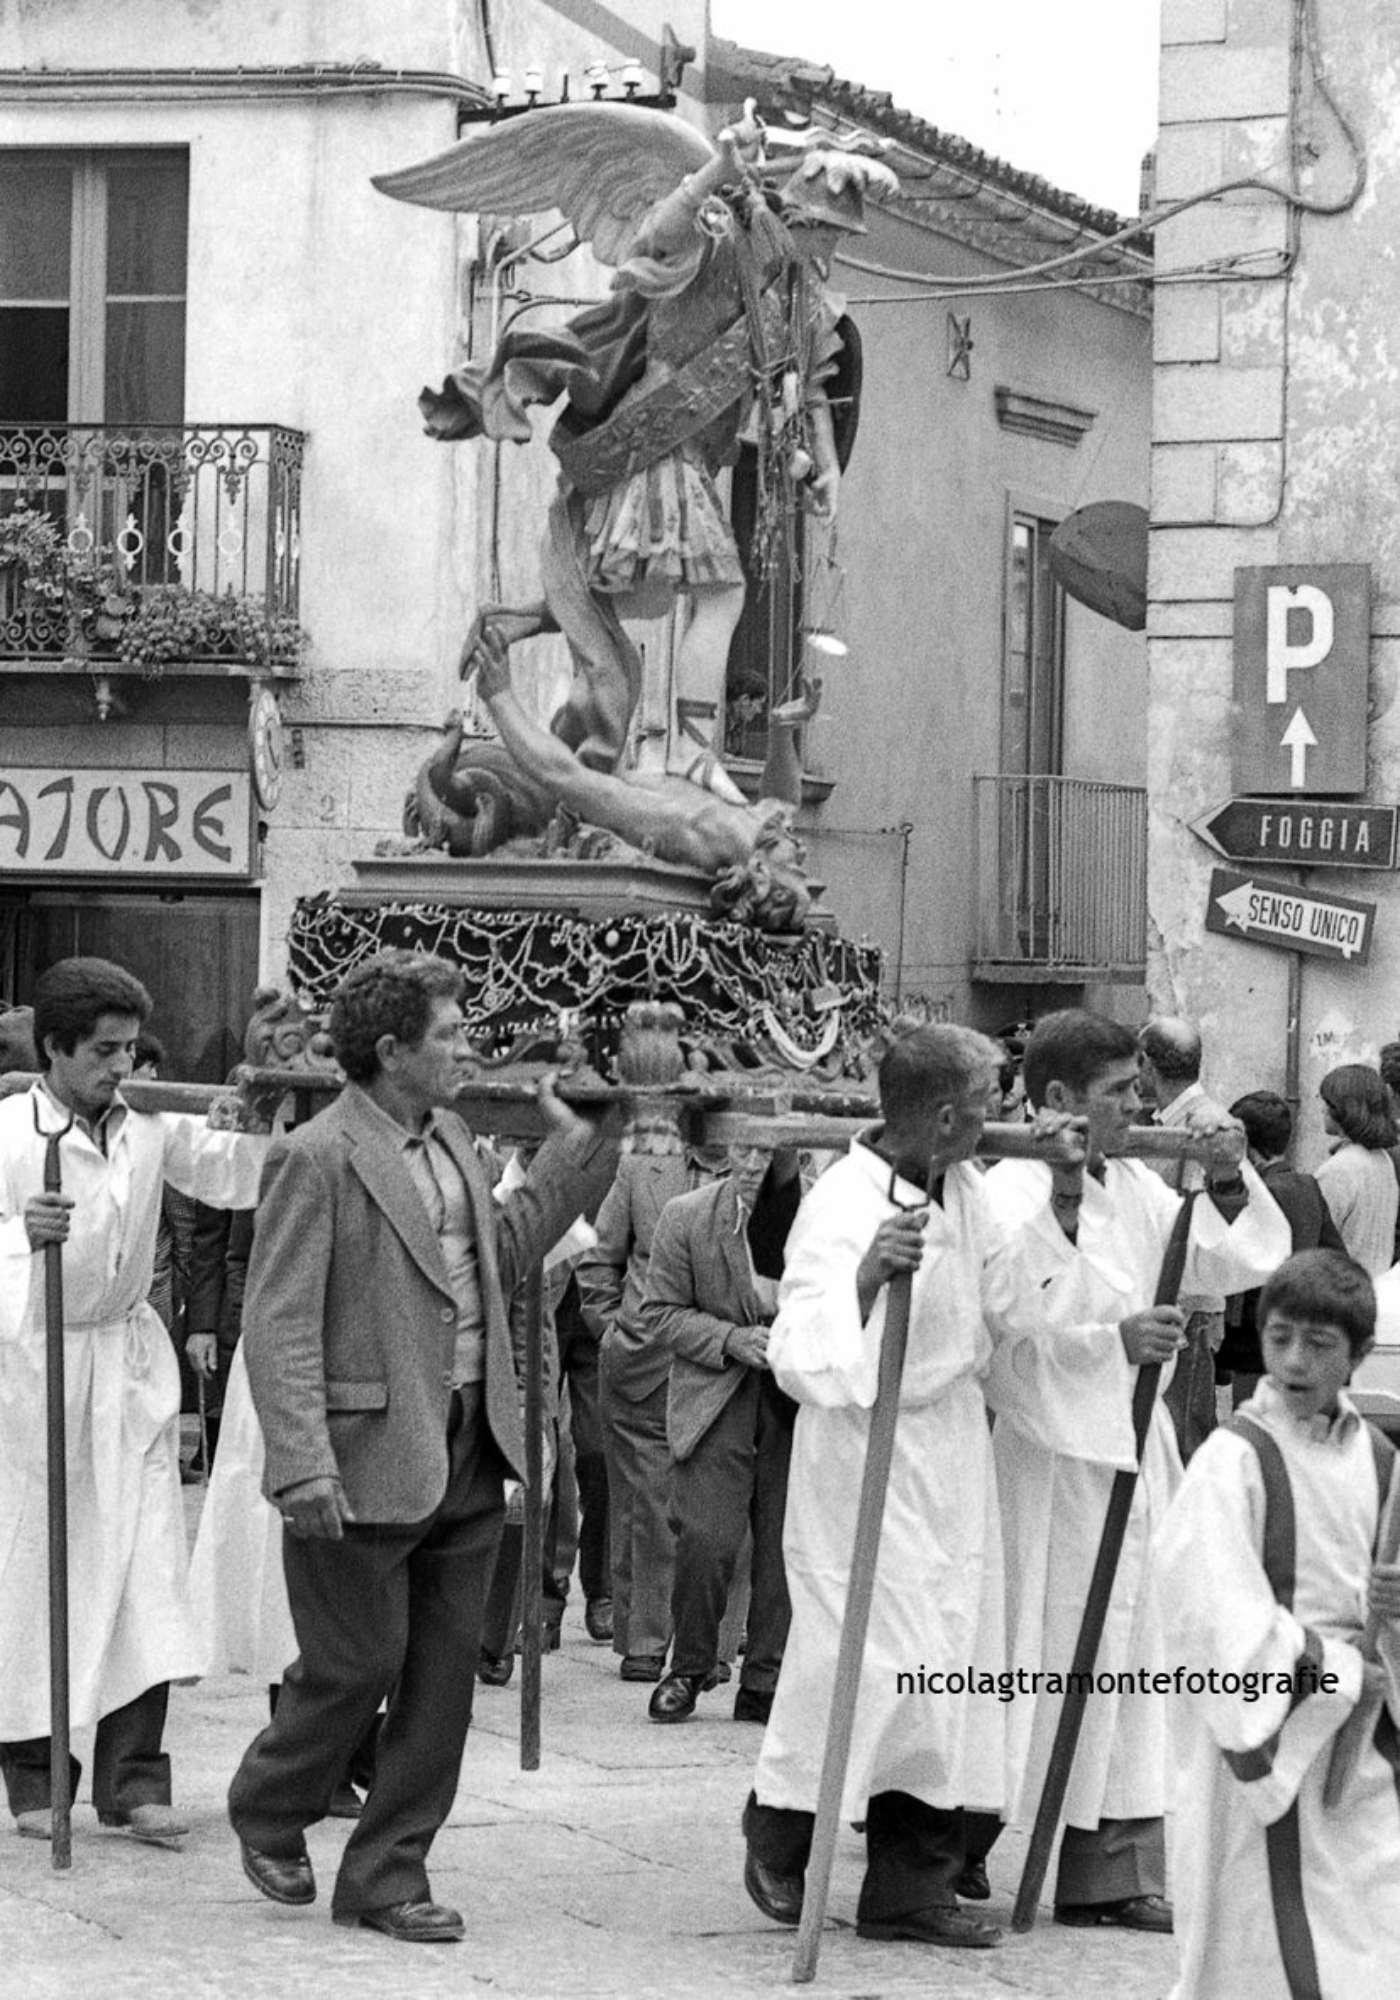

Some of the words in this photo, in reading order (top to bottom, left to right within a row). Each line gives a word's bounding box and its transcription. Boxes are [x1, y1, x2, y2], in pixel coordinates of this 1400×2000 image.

[1267, 584, 1334, 703] P
[1260, 815, 1370, 852] FOGGIA
[1249, 894, 1304, 932] SENSO
[1310, 907, 1360, 945] UNICO
